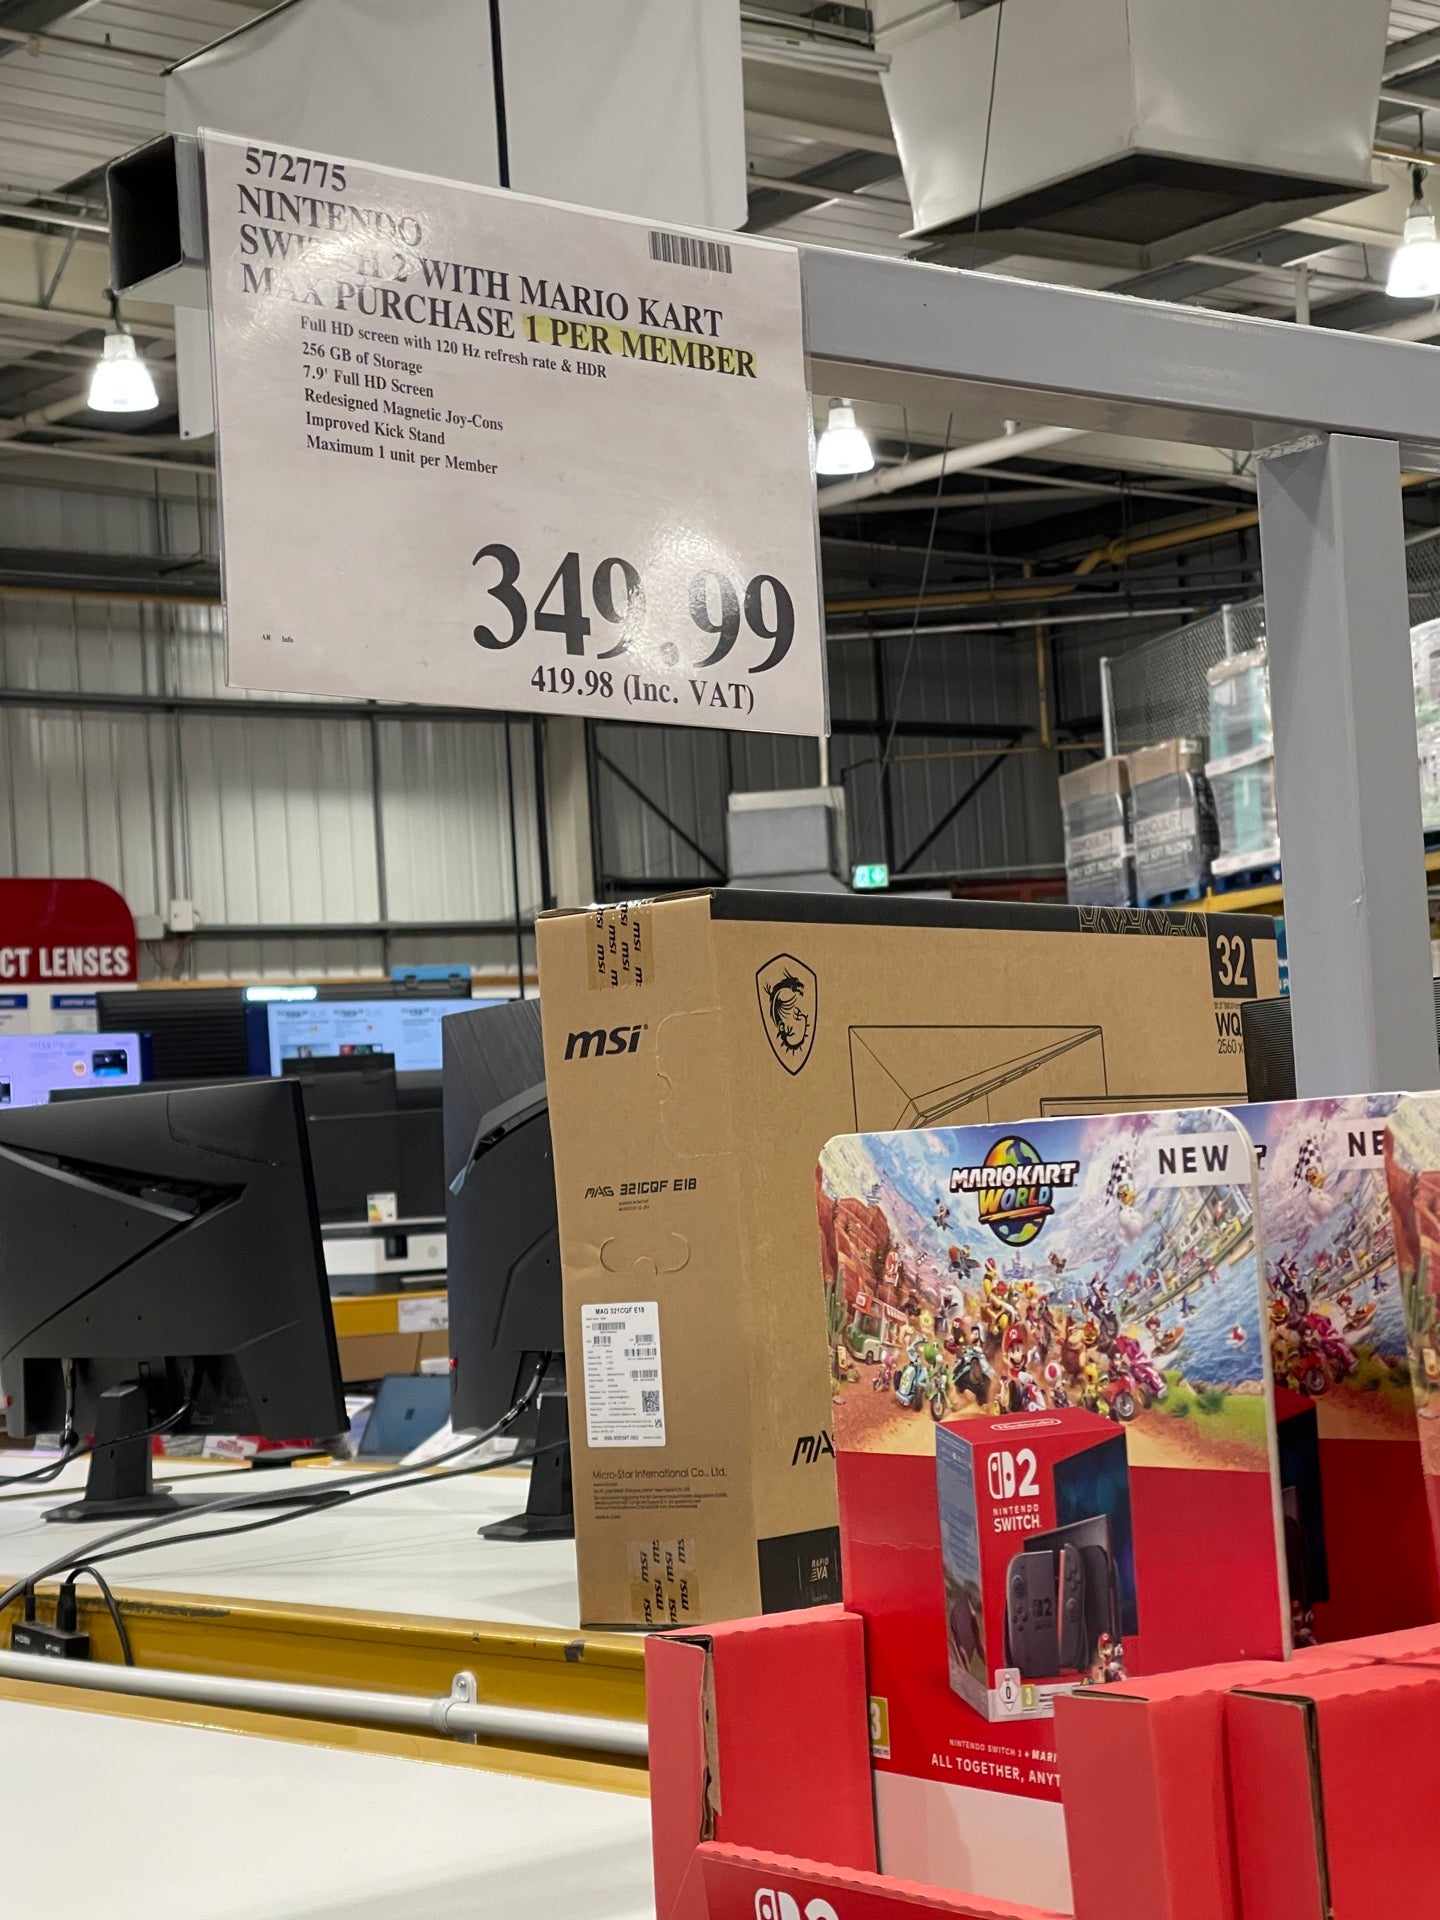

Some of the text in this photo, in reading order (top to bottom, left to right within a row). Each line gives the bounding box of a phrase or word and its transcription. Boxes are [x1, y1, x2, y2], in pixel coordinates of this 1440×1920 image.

[246, 147, 346, 192] 572775
[237, 183, 422, 247] NINTENDO
[393, 253, 409, 283] 2
[421, 258, 510, 301] WITH
[519, 276, 628, 321] MARIO
[638, 297, 723, 337] KART
[301, 315, 607, 378] Full HD screen with 120 Hz refresh rate & HDR
[336, 281, 515, 339] PURCHASE
[526, 315, 540, 343] 1
[549, 317, 612, 355] PER
[620, 330, 757, 378] MEMBER
[302, 341, 423, 376] 256 GB of Storage
[303, 364, 434, 398] 7.9' Full HD Screen
[304, 387, 504, 431] Redesigned Magnetic Joy-Cons
[306, 411, 445, 445] Improved Kick Stand
[306, 434, 498, 475] Maximum 1 unit per Member
[472, 542, 795, 674] 349.99
[530, 665, 755, 715] 419.98 (Inc. VAT)
[0, 945, 130, 978] CT LENSES
[1216, 934, 1248, 986] 32
[1217, 1039, 1236, 1054] 2560
[1158, 1143, 1230, 1175] NEW
[585, 1186, 614, 1199] MAG
[979, 1186, 1051, 1215] WORLD
[792, 1430, 835, 1466] MA
[593, 1469, 633, 1480] Micro-Star
[635, 1467, 689, 1478] International
[1016, 1448, 1039, 1497] 2
[993, 1503, 1039, 1516] NINTENDO
[994, 1514, 1040, 1533] SWITCH
[870, 1702, 881, 1740] 3
[949, 1738, 986, 1751] NINTENDO
[987, 1744, 1016, 1757] SWITCH
[1031, 1749, 1057, 1763] MARI
[931, 1753, 1061, 1787] ALL TOGETHER, ANYT
